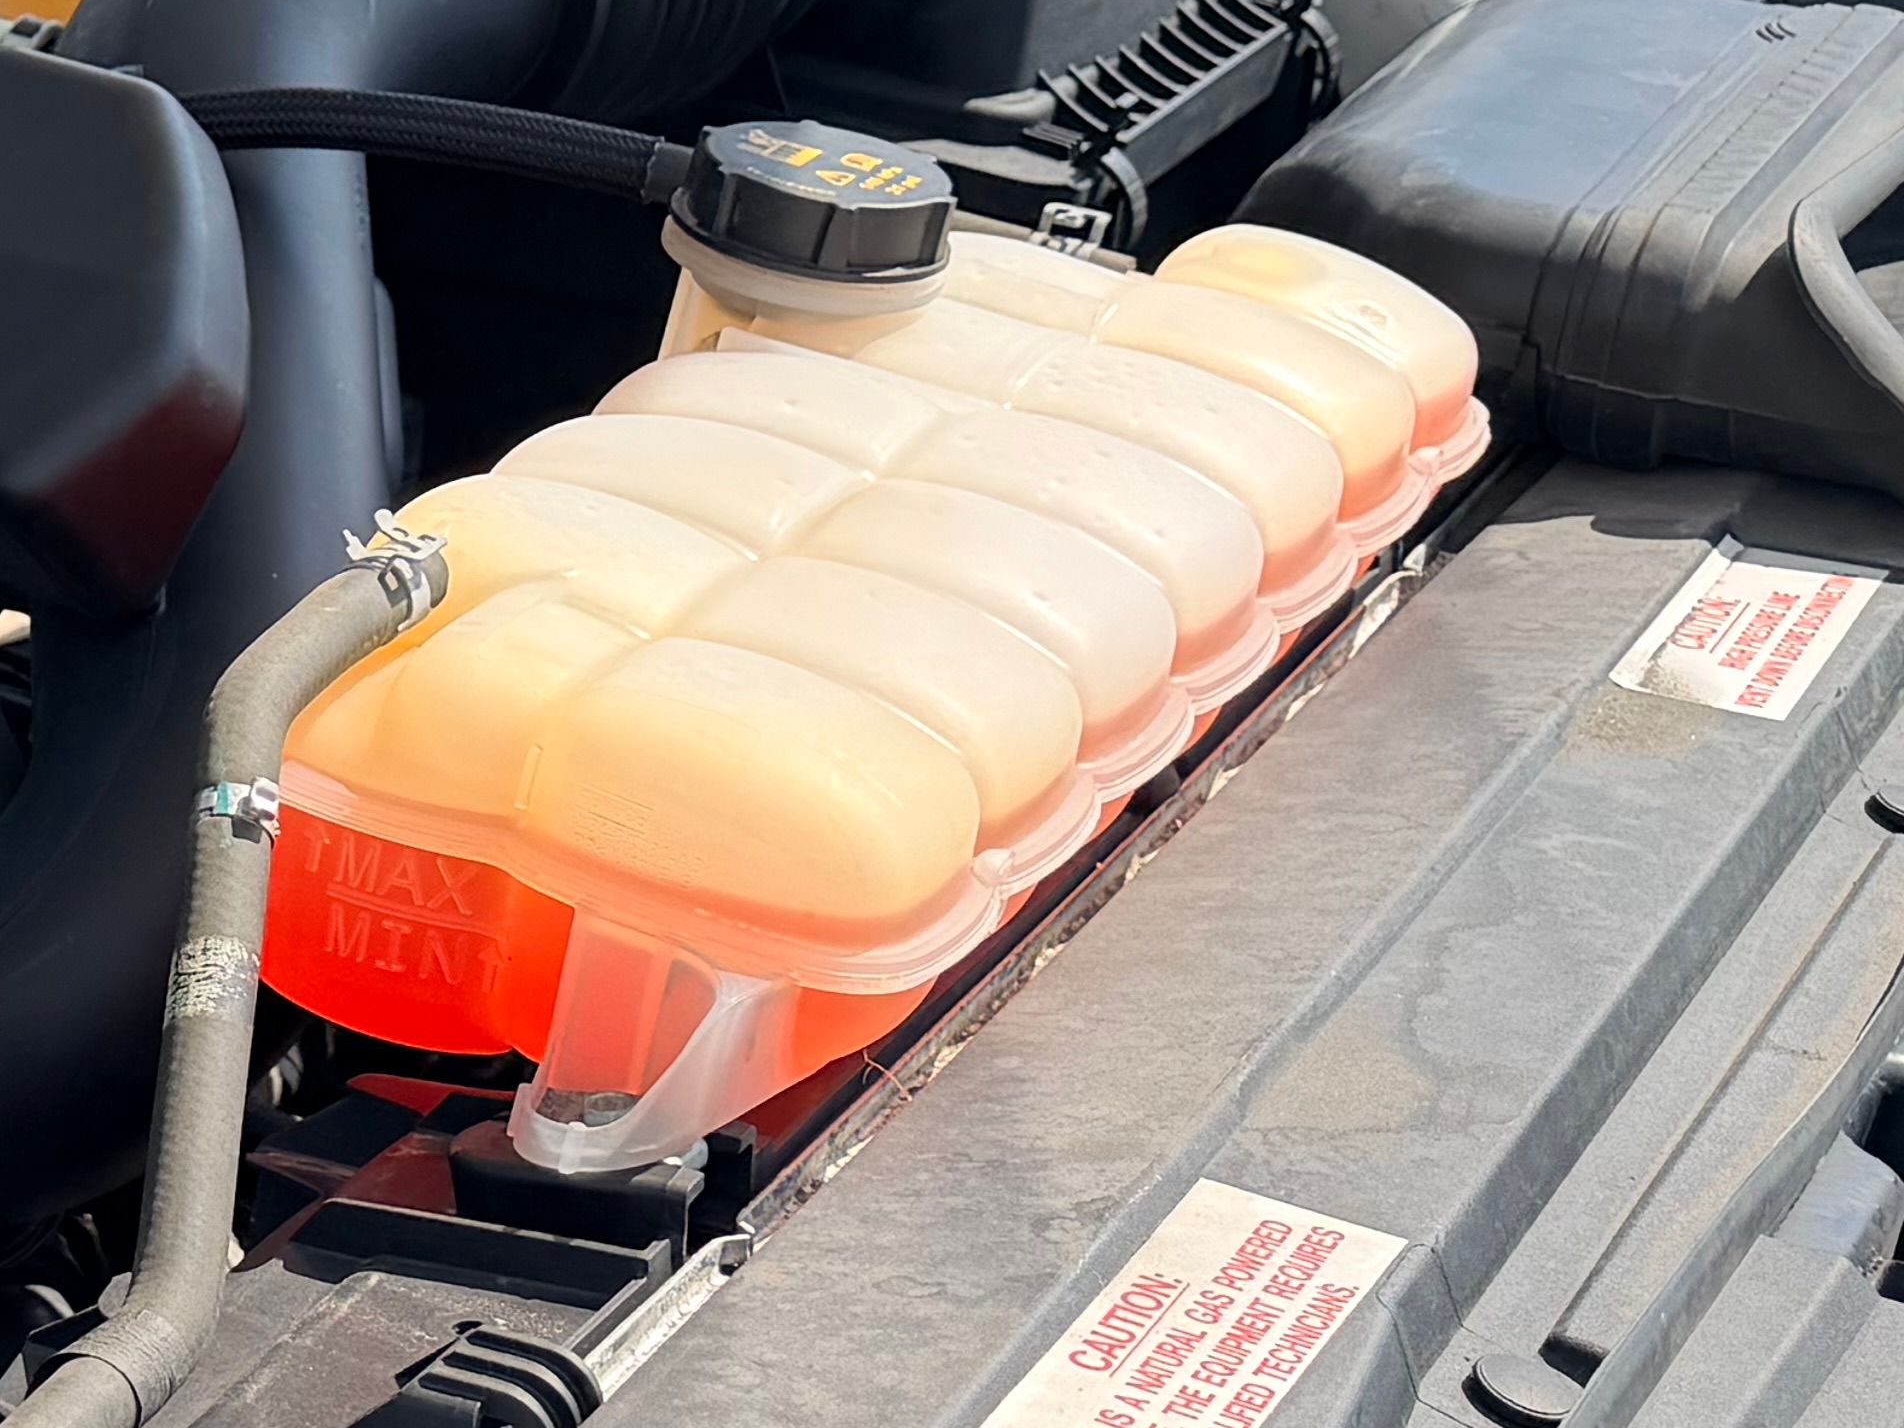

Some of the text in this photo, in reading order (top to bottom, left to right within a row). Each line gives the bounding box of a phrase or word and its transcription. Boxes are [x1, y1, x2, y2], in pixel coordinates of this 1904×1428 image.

[1666, 593, 1741, 652] CAUTION:
[332, 834, 482, 917] MAX
[324, 903, 466, 986] MIN
[1210, 1217, 1297, 1292] POWERED
[1063, 1267, 1184, 1376] CAUTION:
[1161, 1382, 1217, 1424] THE
[1190, 1296, 1288, 1388] EQUIPMENT
[1260, 1224, 1348, 1301] REQUIRES
[1181, 1287, 1237, 1326] GAS
[1251, 1276, 1361, 1385] TECHNICIANS.
[1123, 1321, 1209, 1396] NATURAL
[1110, 1389, 1151, 1411] A
